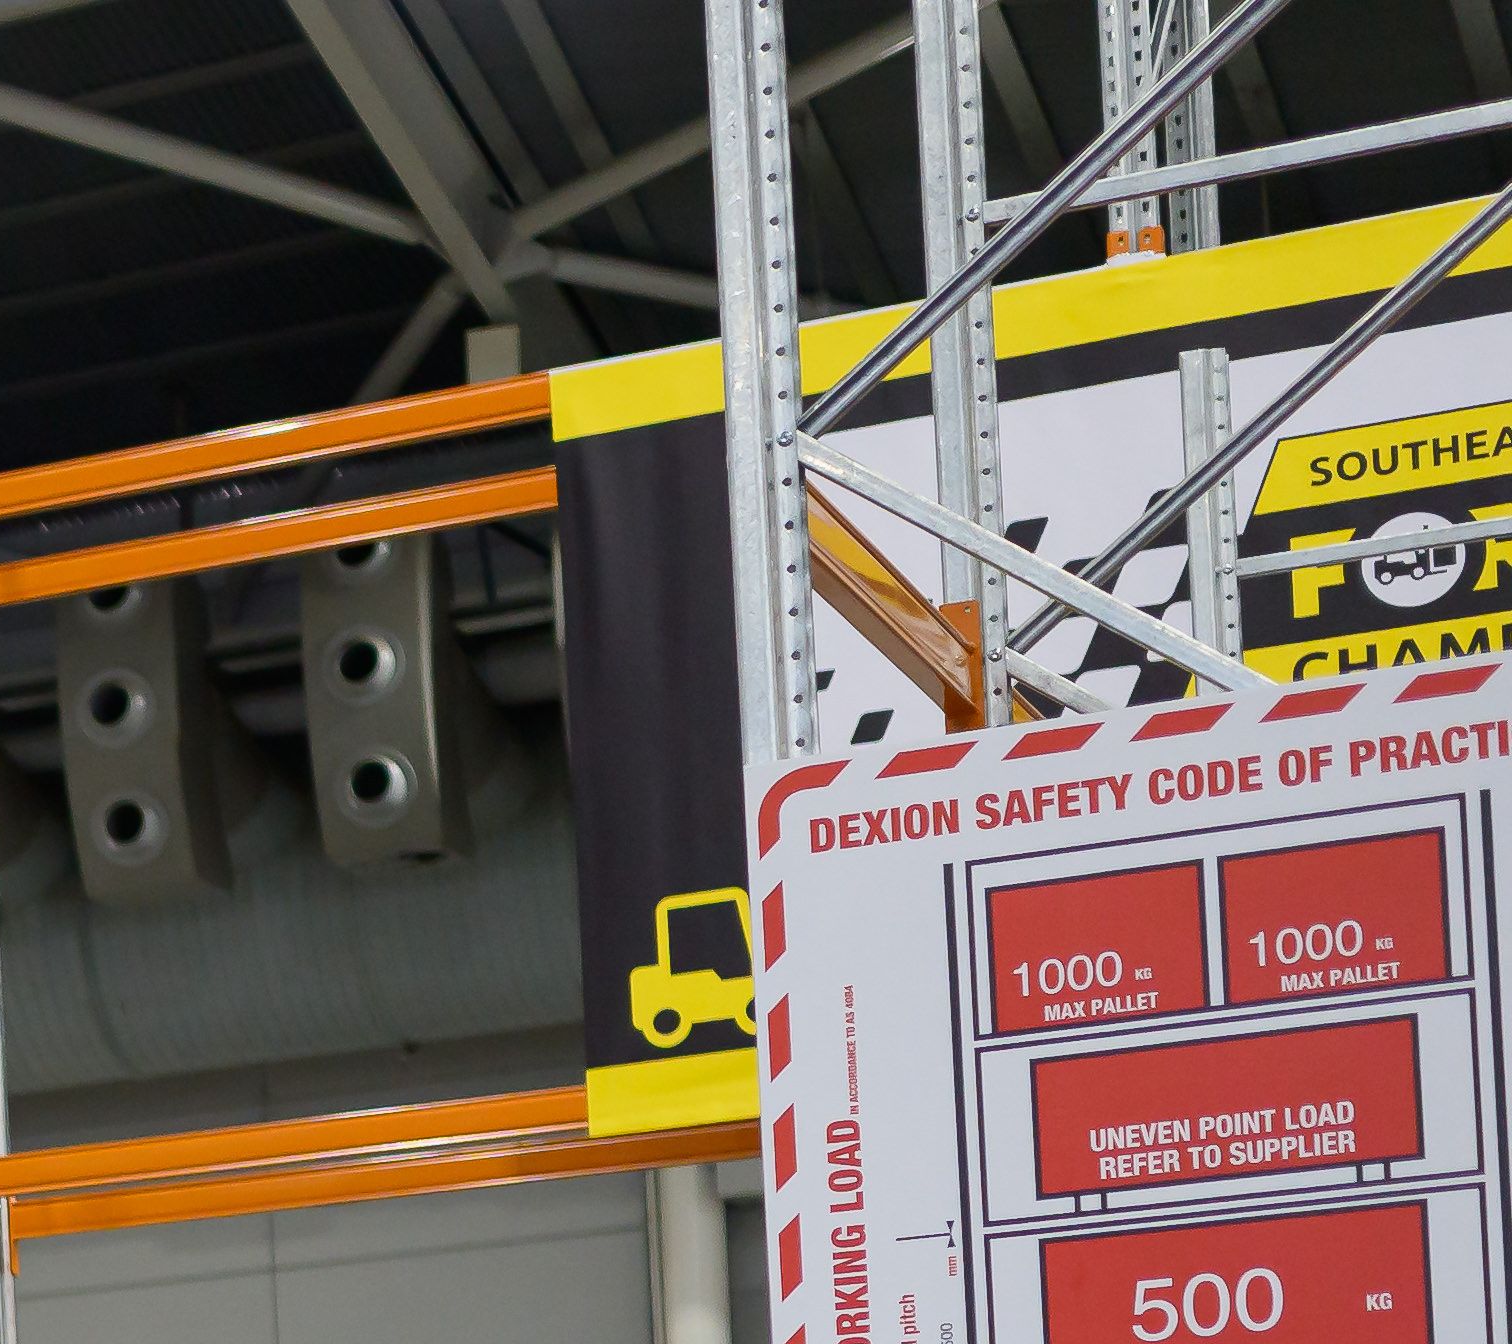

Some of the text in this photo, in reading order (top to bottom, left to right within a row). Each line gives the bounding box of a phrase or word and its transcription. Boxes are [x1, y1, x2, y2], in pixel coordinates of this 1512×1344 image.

[1293, 626, 1512, 682] CHAM
[810, 720, 1510, 853] DEXION SAFETY CODE OF PRACTI
[1248, 919, 1394, 967] 1000 KG
[1012, 951, 1153, 997] 1000 KG
[1281, 961, 1400, 992] MAX PALLET
[1044, 992, 1159, 1022] MAX PALLET
[1089, 1100, 1355, 1152] UNEVEN POINT LOAD
[827, 1119, 864, 1213] LOAD
[1099, 1130, 1356, 1180] REFER TO SUPPLIER
[948, 1255, 957, 1277] mm
[899, 1294, 921, 1335] pitch
[1132, 1268, 1393, 1342] 500 KG
